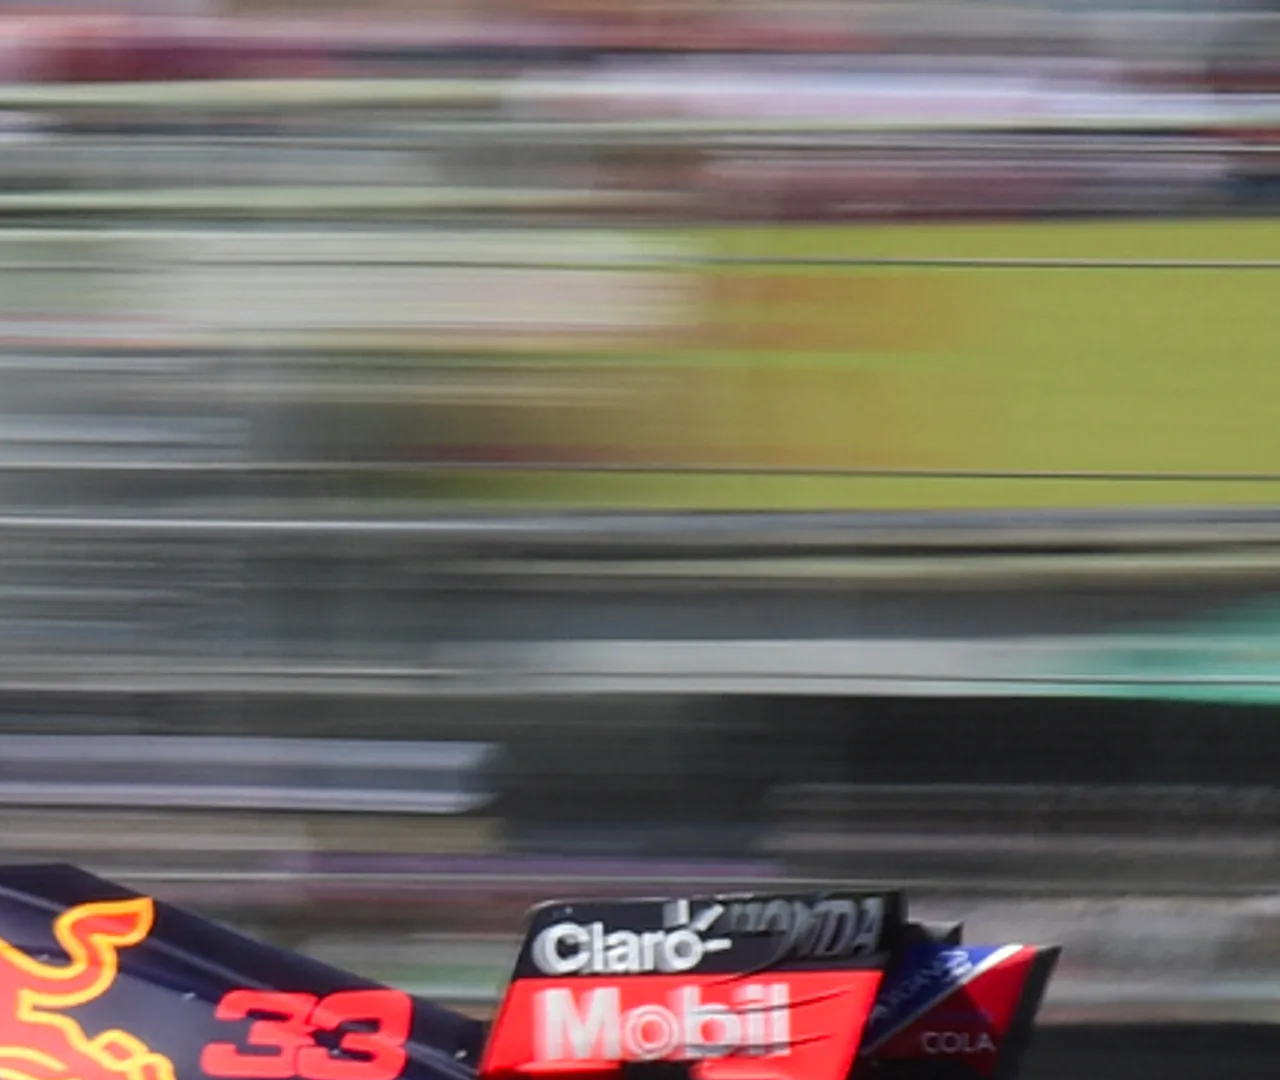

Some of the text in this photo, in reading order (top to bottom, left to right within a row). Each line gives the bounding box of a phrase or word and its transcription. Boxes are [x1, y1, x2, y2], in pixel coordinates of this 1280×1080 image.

[532, 919, 706, 975] Claro
[534, 982, 790, 1061] Mobil
[921, 1031, 996, 1054] COLA
